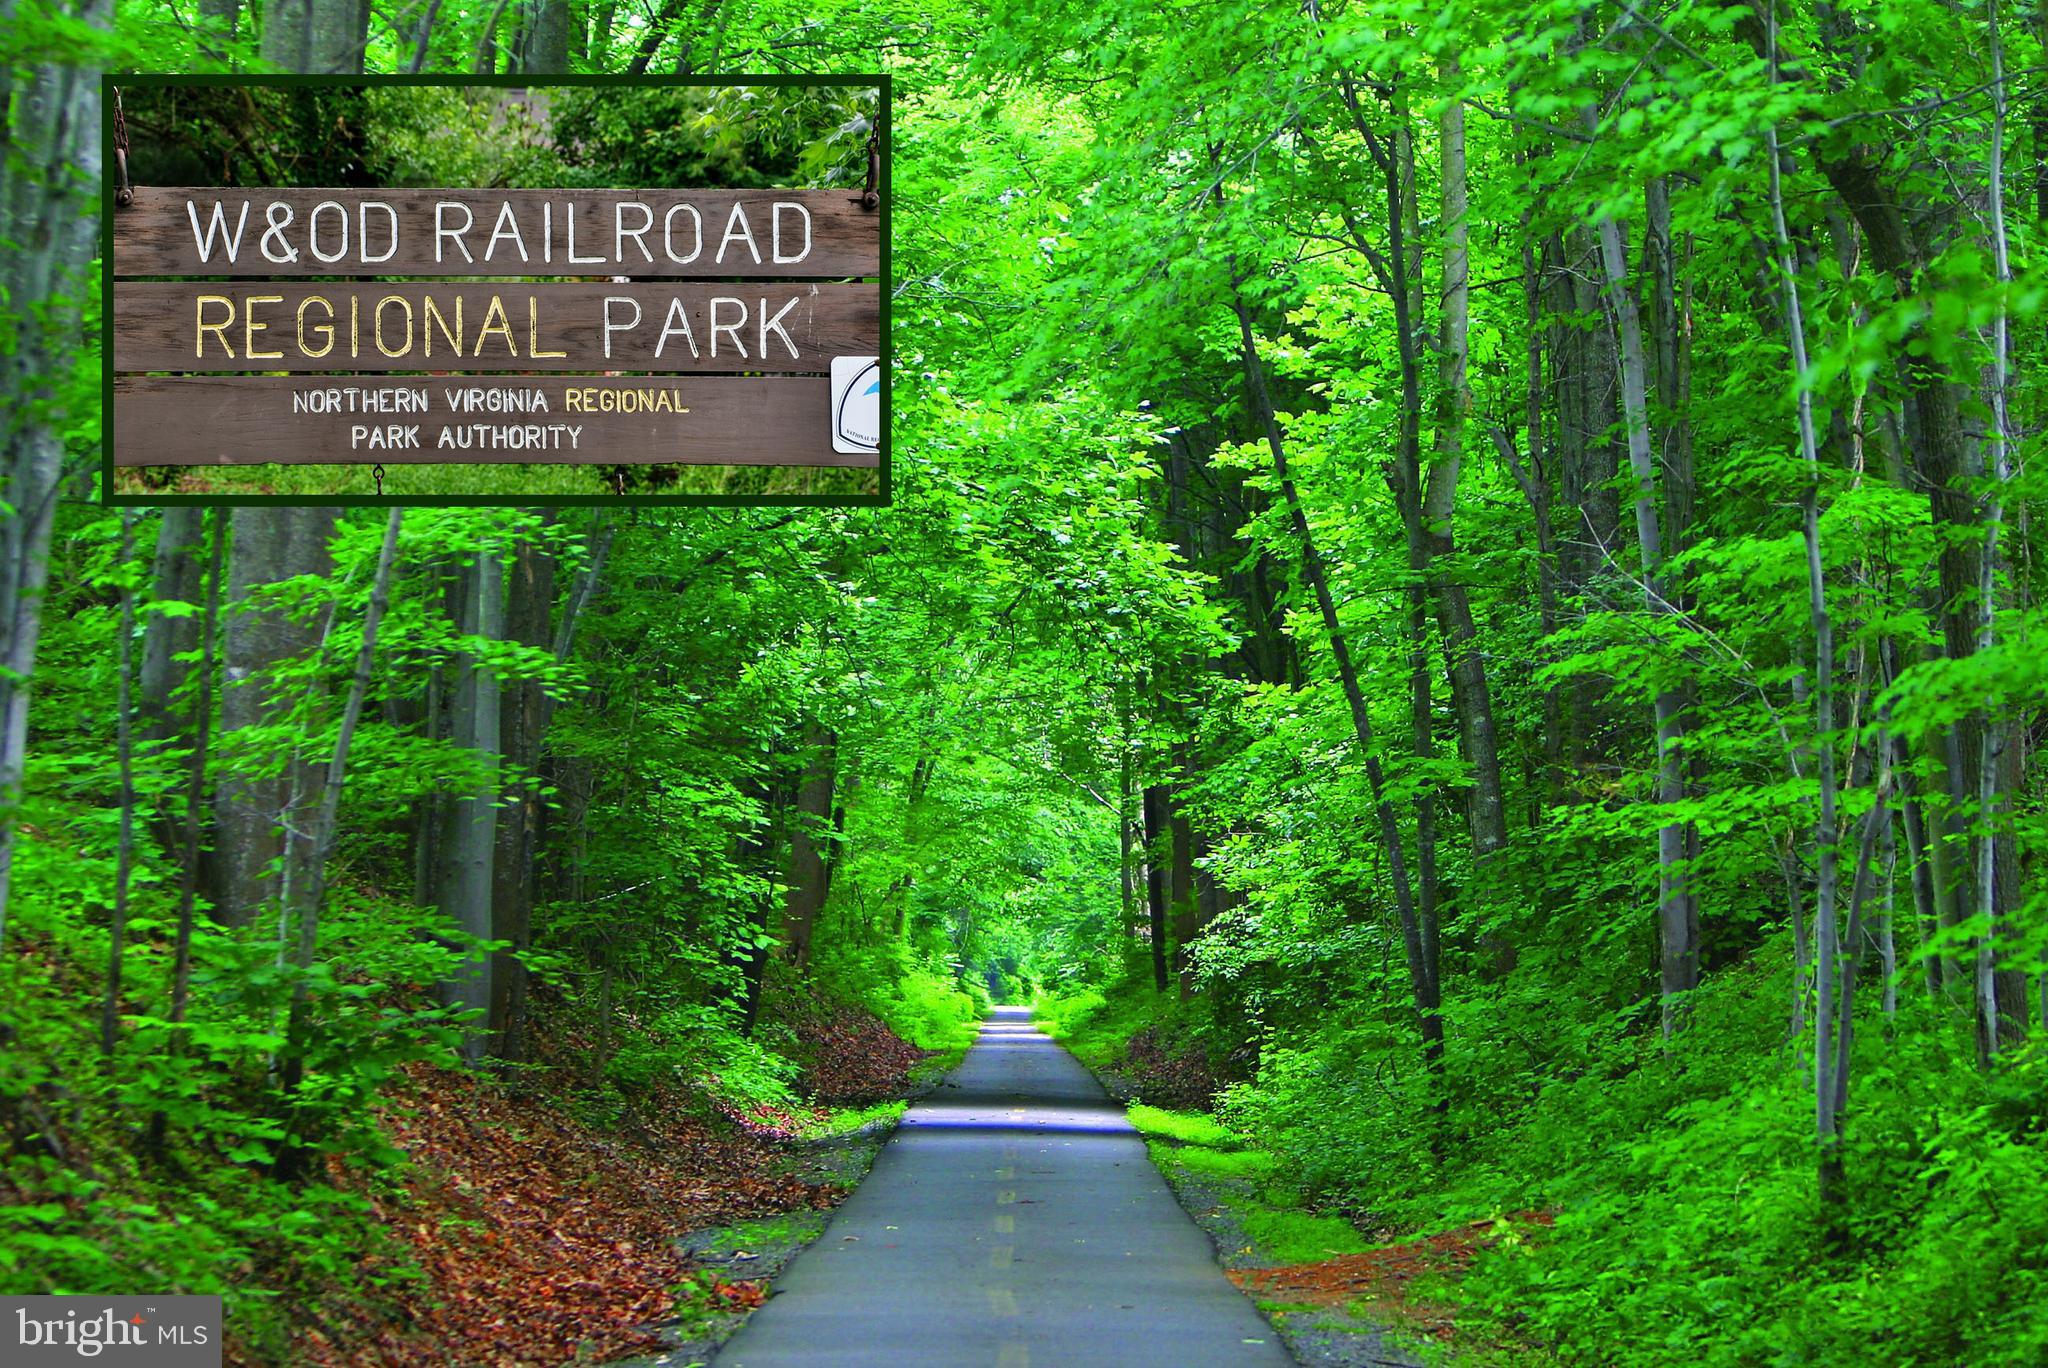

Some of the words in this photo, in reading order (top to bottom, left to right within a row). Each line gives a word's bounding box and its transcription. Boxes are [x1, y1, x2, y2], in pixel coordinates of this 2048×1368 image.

[186, 200, 399, 264] W&OD
[435, 200, 813, 264] RAILROAD
[196, 296, 567, 358] REGIONAL
[604, 297, 800, 360] PARK
[293, 388, 428, 414] NORTHERN
[446, 388, 549, 413] VIRGINIA
[565, 389, 690, 414] REGIONAL
[351, 425, 420, 450] PARK
[437, 424, 583, 450] AUTHORITY
